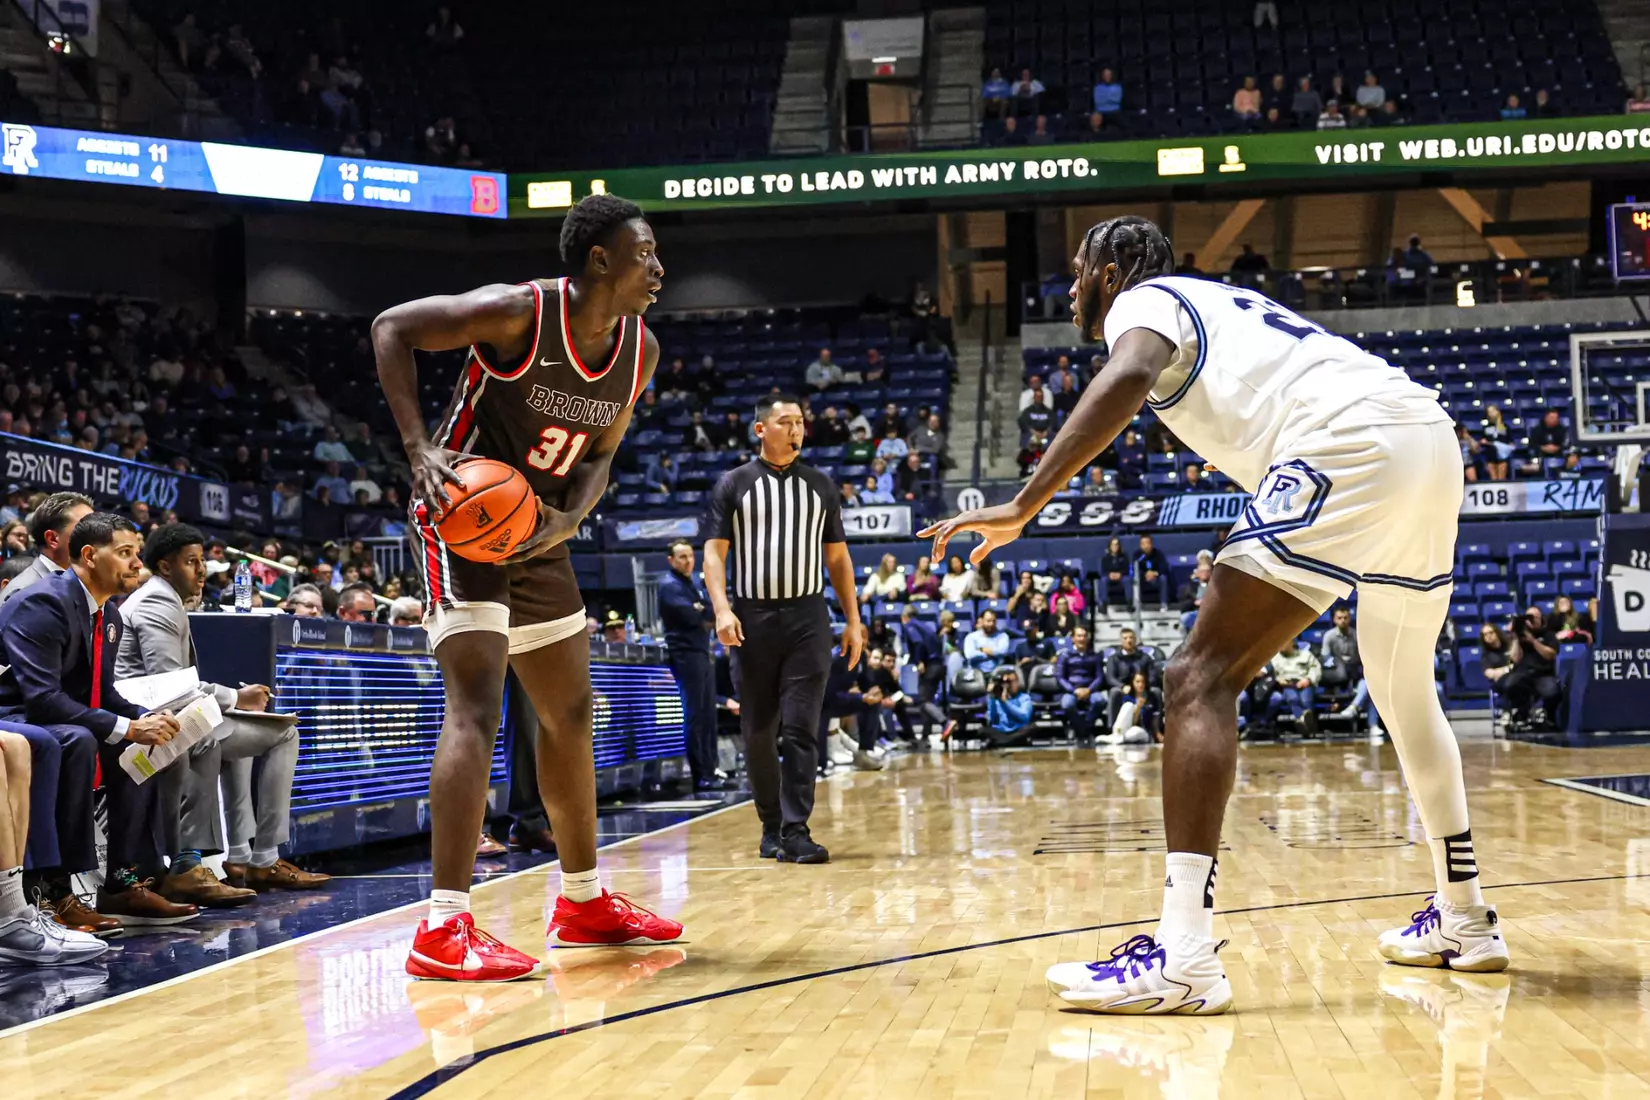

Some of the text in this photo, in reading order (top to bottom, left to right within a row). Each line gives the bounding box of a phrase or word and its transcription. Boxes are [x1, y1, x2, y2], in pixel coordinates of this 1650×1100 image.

[148, 143, 168, 163] 11
[1315, 142, 1385, 165] VISIT
[151, 165, 164, 183] 4
[338, 163, 358, 182] 12
[664, 176, 755, 199] DECIDE
[761, 174, 793, 194] TO
[800, 170, 864, 192] LEAD
[871, 166, 937, 188] WITH
[944, 161, 1016, 185] ARMY
[470, 175, 499, 214] B
[526, 384, 621, 427] BROWN
[526, 425, 588, 478] 31
[6, 450, 179, 510] BRING THE RUCKUS
[1469, 489, 1509, 507] 108
[853, 513, 891, 530] 107
[1594, 649, 1632, 661] SOUTH
